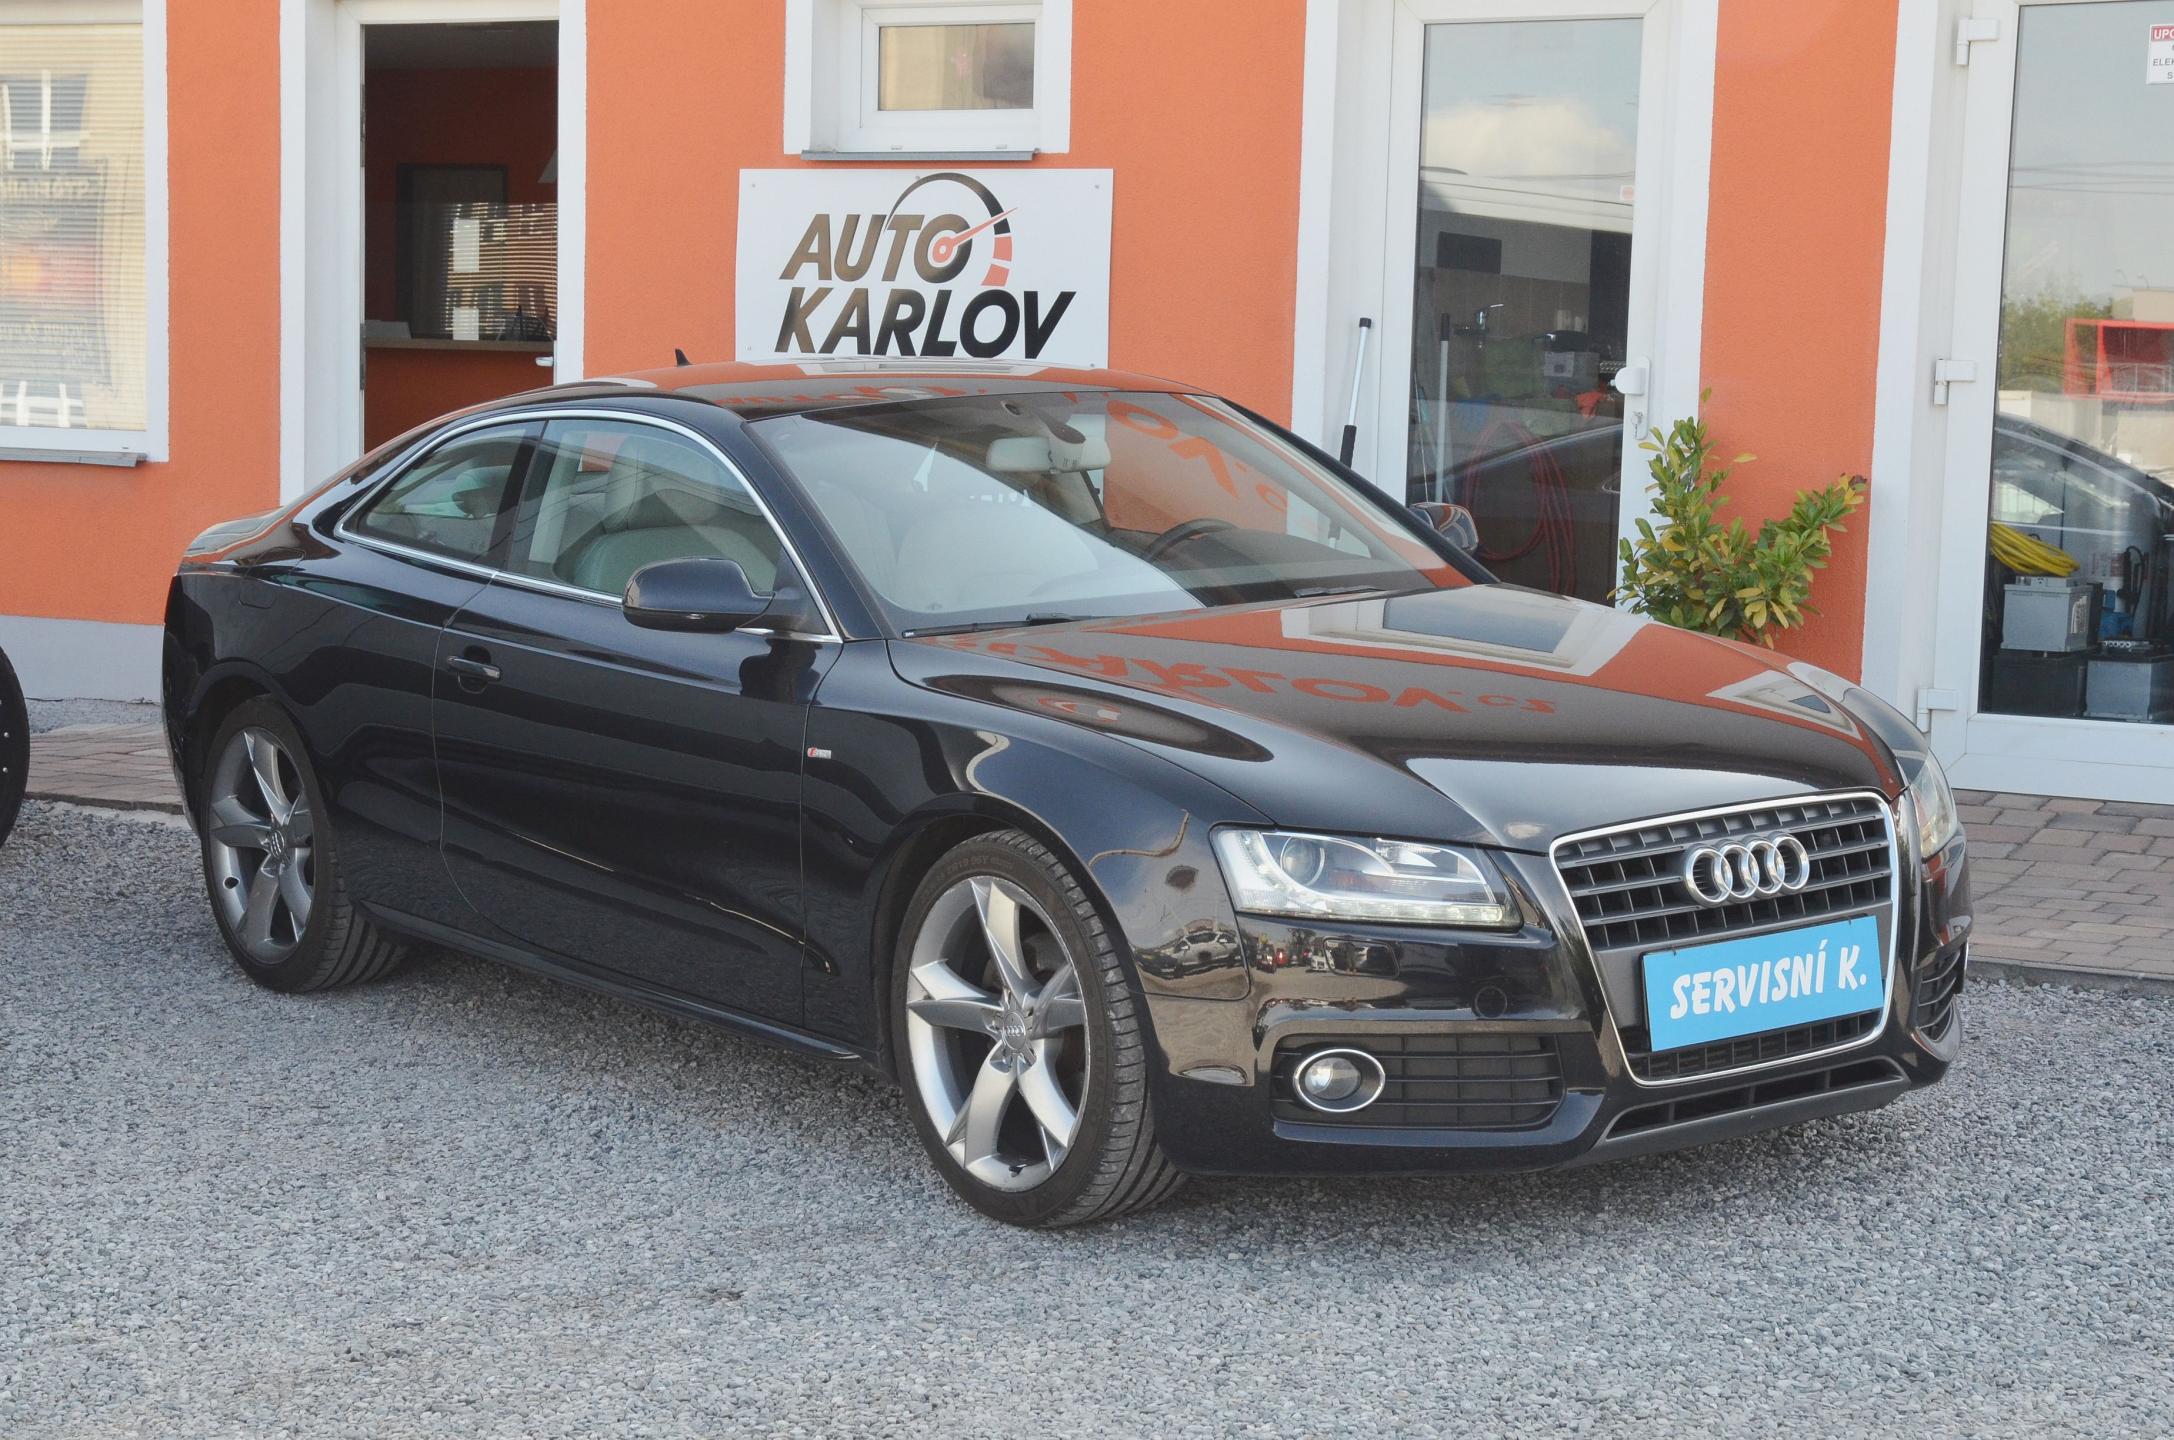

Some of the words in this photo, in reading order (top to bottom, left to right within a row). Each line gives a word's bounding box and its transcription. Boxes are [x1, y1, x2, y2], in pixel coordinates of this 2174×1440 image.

[779, 213, 973, 284] AUTO
[774, 286, 1077, 359] KARLOV
[1670, 939, 1828, 1019] SERVISNÍ
[1838, 945, 1867, 991] K.
